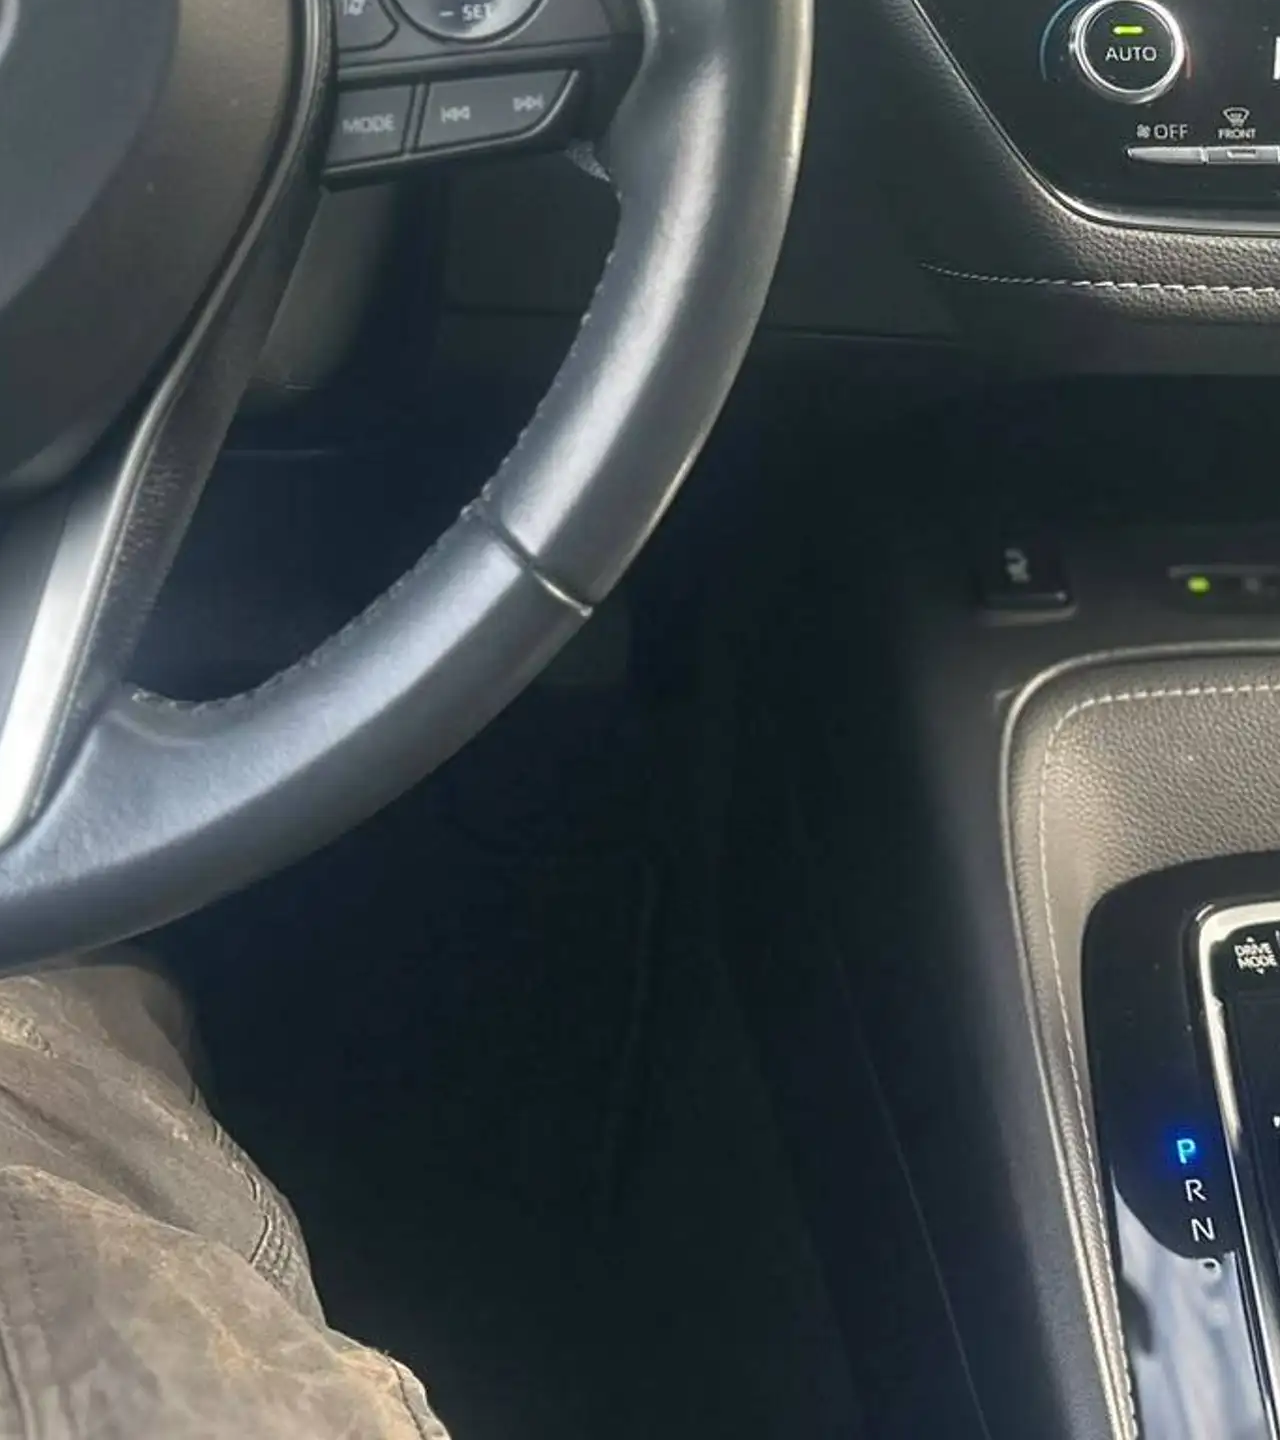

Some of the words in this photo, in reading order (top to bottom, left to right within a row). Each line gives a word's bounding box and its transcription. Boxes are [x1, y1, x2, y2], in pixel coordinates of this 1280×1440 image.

[1105, 45, 1158, 63] AUTO
[341, 114, 396, 135] MODE
[1153, 123, 1189, 140] OFF
[1217, 127, 1257, 140] FRONT
[1176, 1138, 1197, 1164] P
[1185, 1178, 1207, 1202] R
[1190, 1216, 1217, 1242] N
